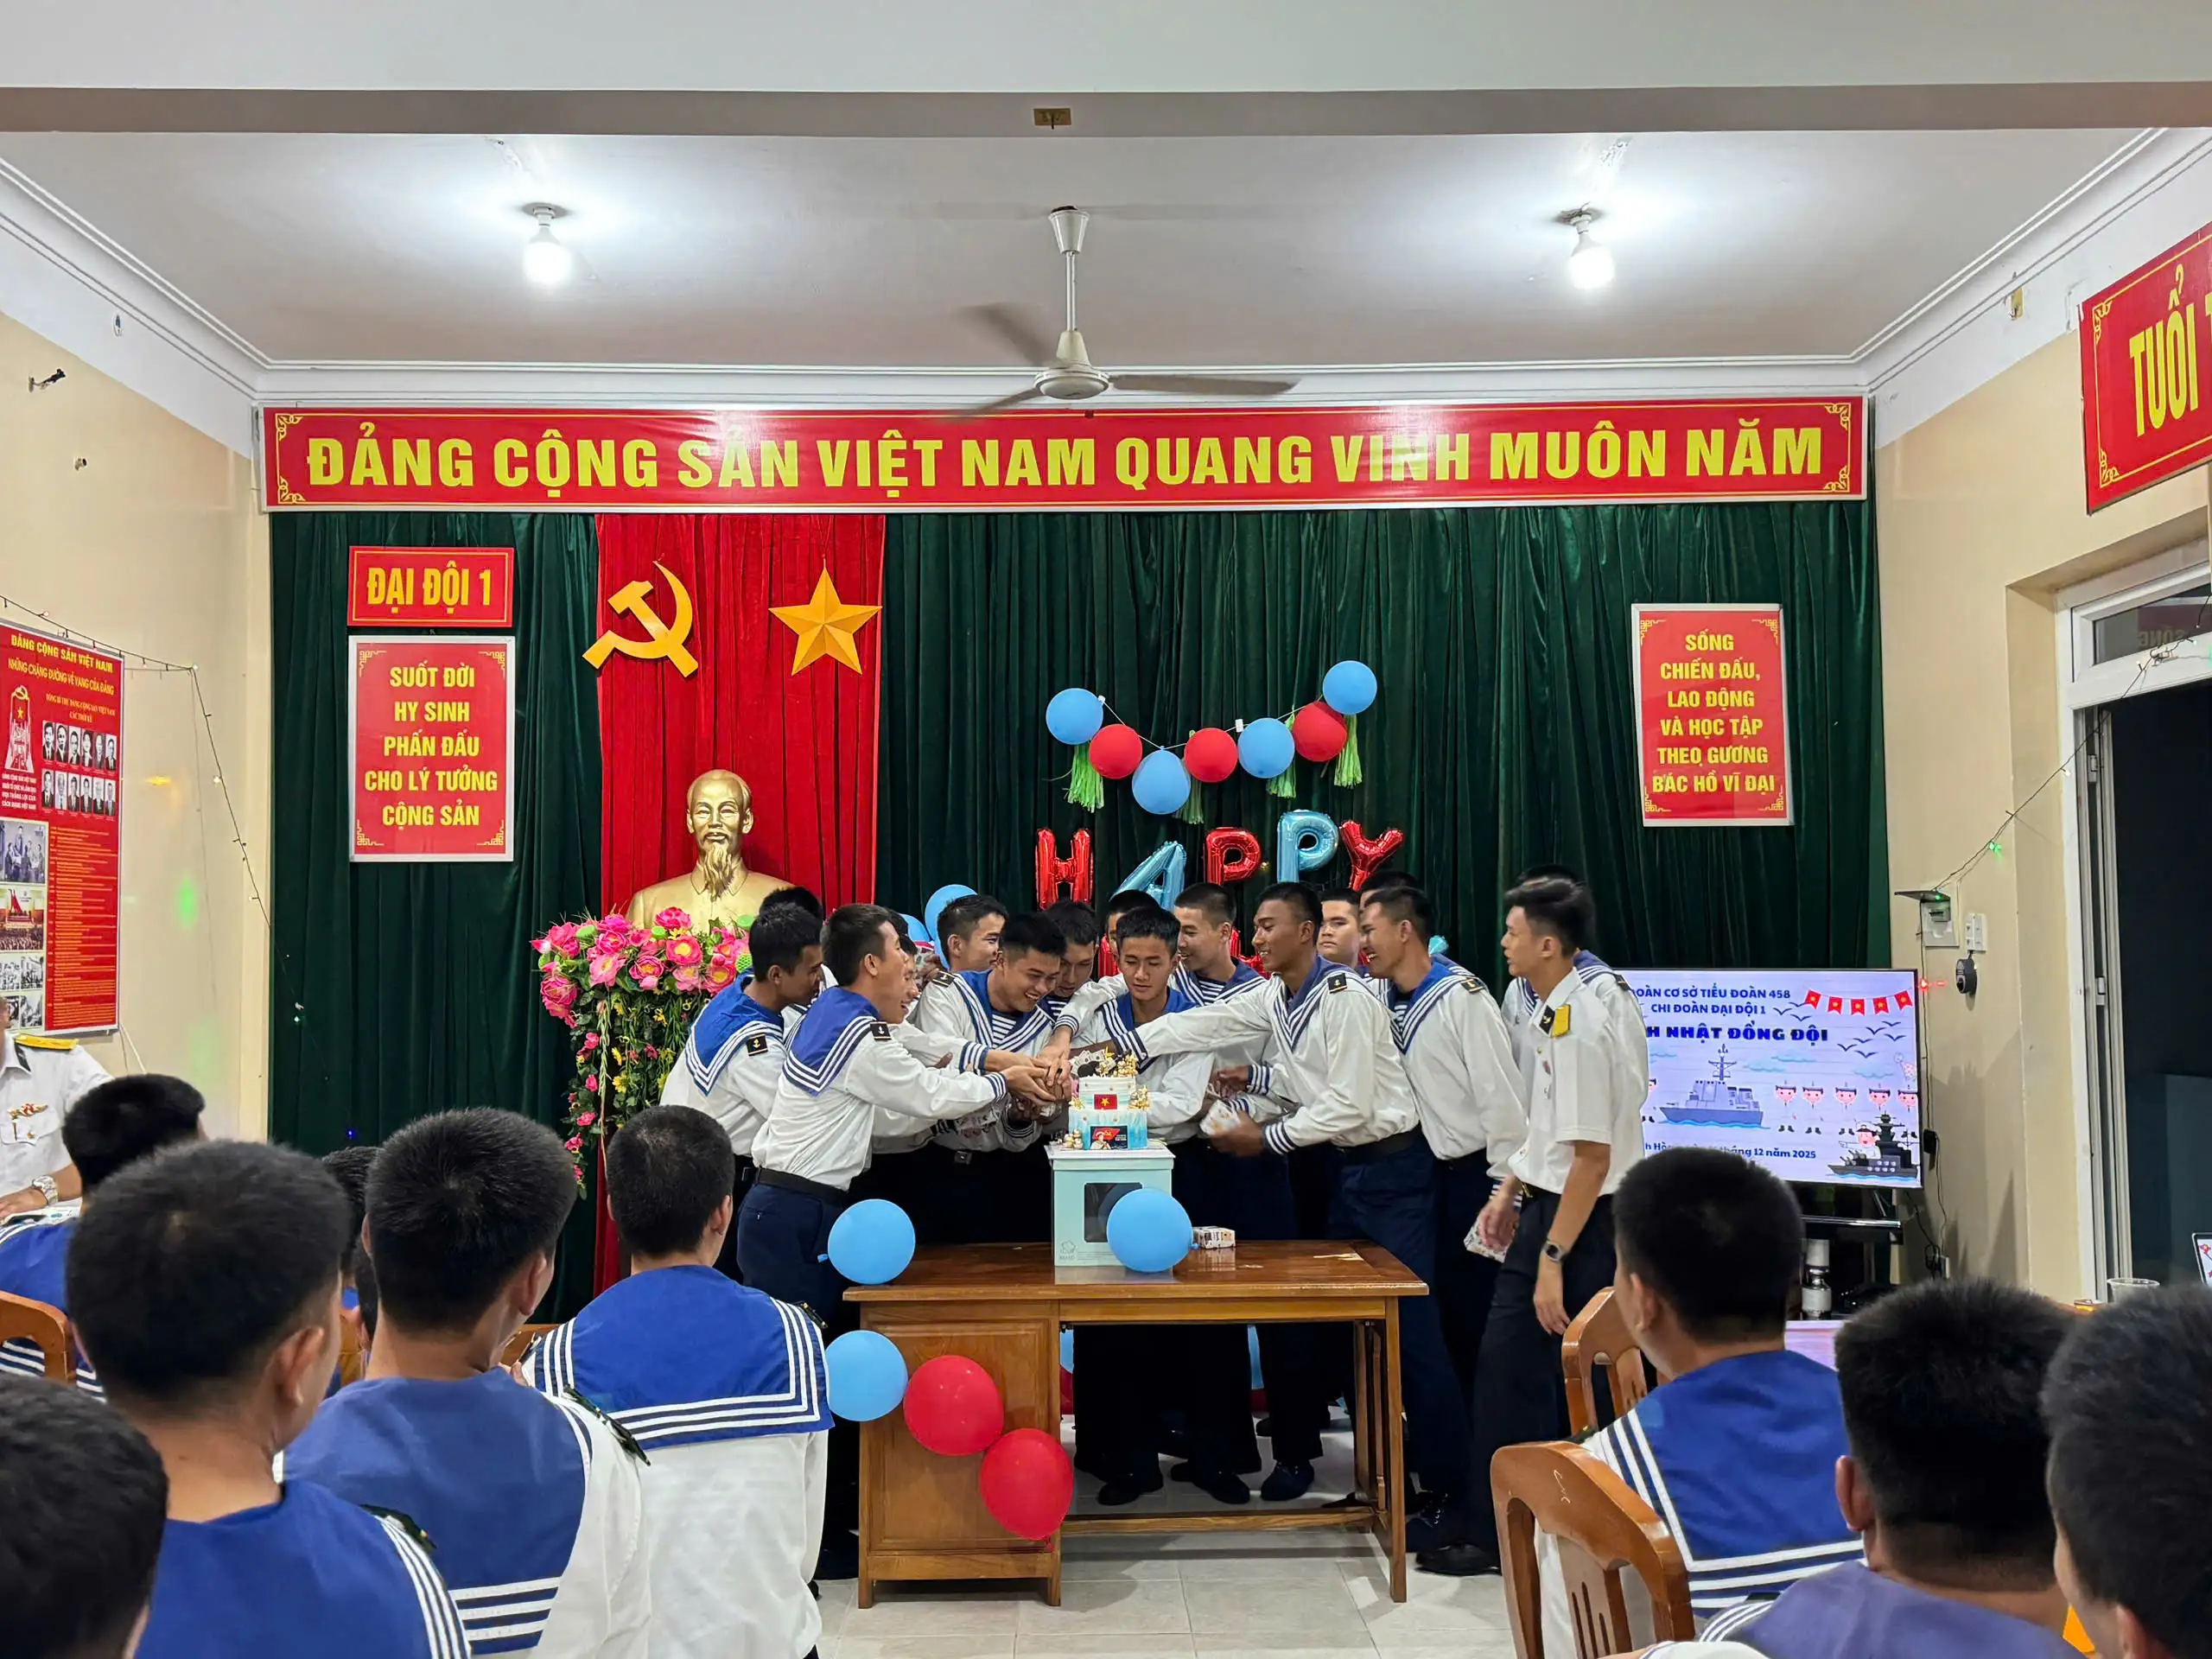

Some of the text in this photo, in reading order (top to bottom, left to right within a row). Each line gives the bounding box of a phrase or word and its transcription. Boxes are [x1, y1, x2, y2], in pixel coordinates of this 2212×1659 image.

[2129, 264, 2198, 437] TUỔI
[307, 417, 1821, 498] ĐẢNG CỘNG SẢN VIỆT NAM QUANG VINH MUÔN NĂM
[367, 560, 491, 614] ĐẠI ĐỘI 1
[1686, 629, 1734, 651] SỐNG
[11, 632, 113, 674] ĐẢNG CỘNG SẢN VIỆT NAM
[390, 660, 475, 688] SUỐT ĐỜI
[1660, 657, 1760, 681] CHIẾN ĐẤU,
[1668, 688, 1755, 710] LAO ĐỘNG
[394, 702, 470, 722] HY SINH
[1660, 715, 1764, 739] VÀ HỌC TẬP
[384, 728, 480, 757] PHẤN ĐẤU
[1707, 745, 1769, 764] GƯƠNG
[365, 764, 498, 791] CHO LÝ TƯỞNG
[1652, 770, 1775, 795] BÁC HỒ VĨ ĐẠI
[382, 798, 480, 830] CỘNG SẢN
[1035, 809, 1404, 911] HAPPY
[1663, 988, 1681, 998] CƠ
[1682, 985, 1698, 998] SỞ
[1700, 982, 1727, 998] TIỂU
[1730, 985, 1766, 999] ĐOÀN
[1769, 989, 1790, 999] 458
[1651, 1000, 1766, 1017] CHI ĐOÀN ĐẠI ĐỘI 1
[1666, 1022, 1722, 1044] NHẬT
[1727, 1020, 1785, 1041] ĐỒNG
[1789, 1024, 1828, 1046] ĐỘI
[1754, 1147, 1764, 1156] 12
[1765, 1147, 1791, 1158] năm
[1793, 1149, 1816, 1159] 2025
